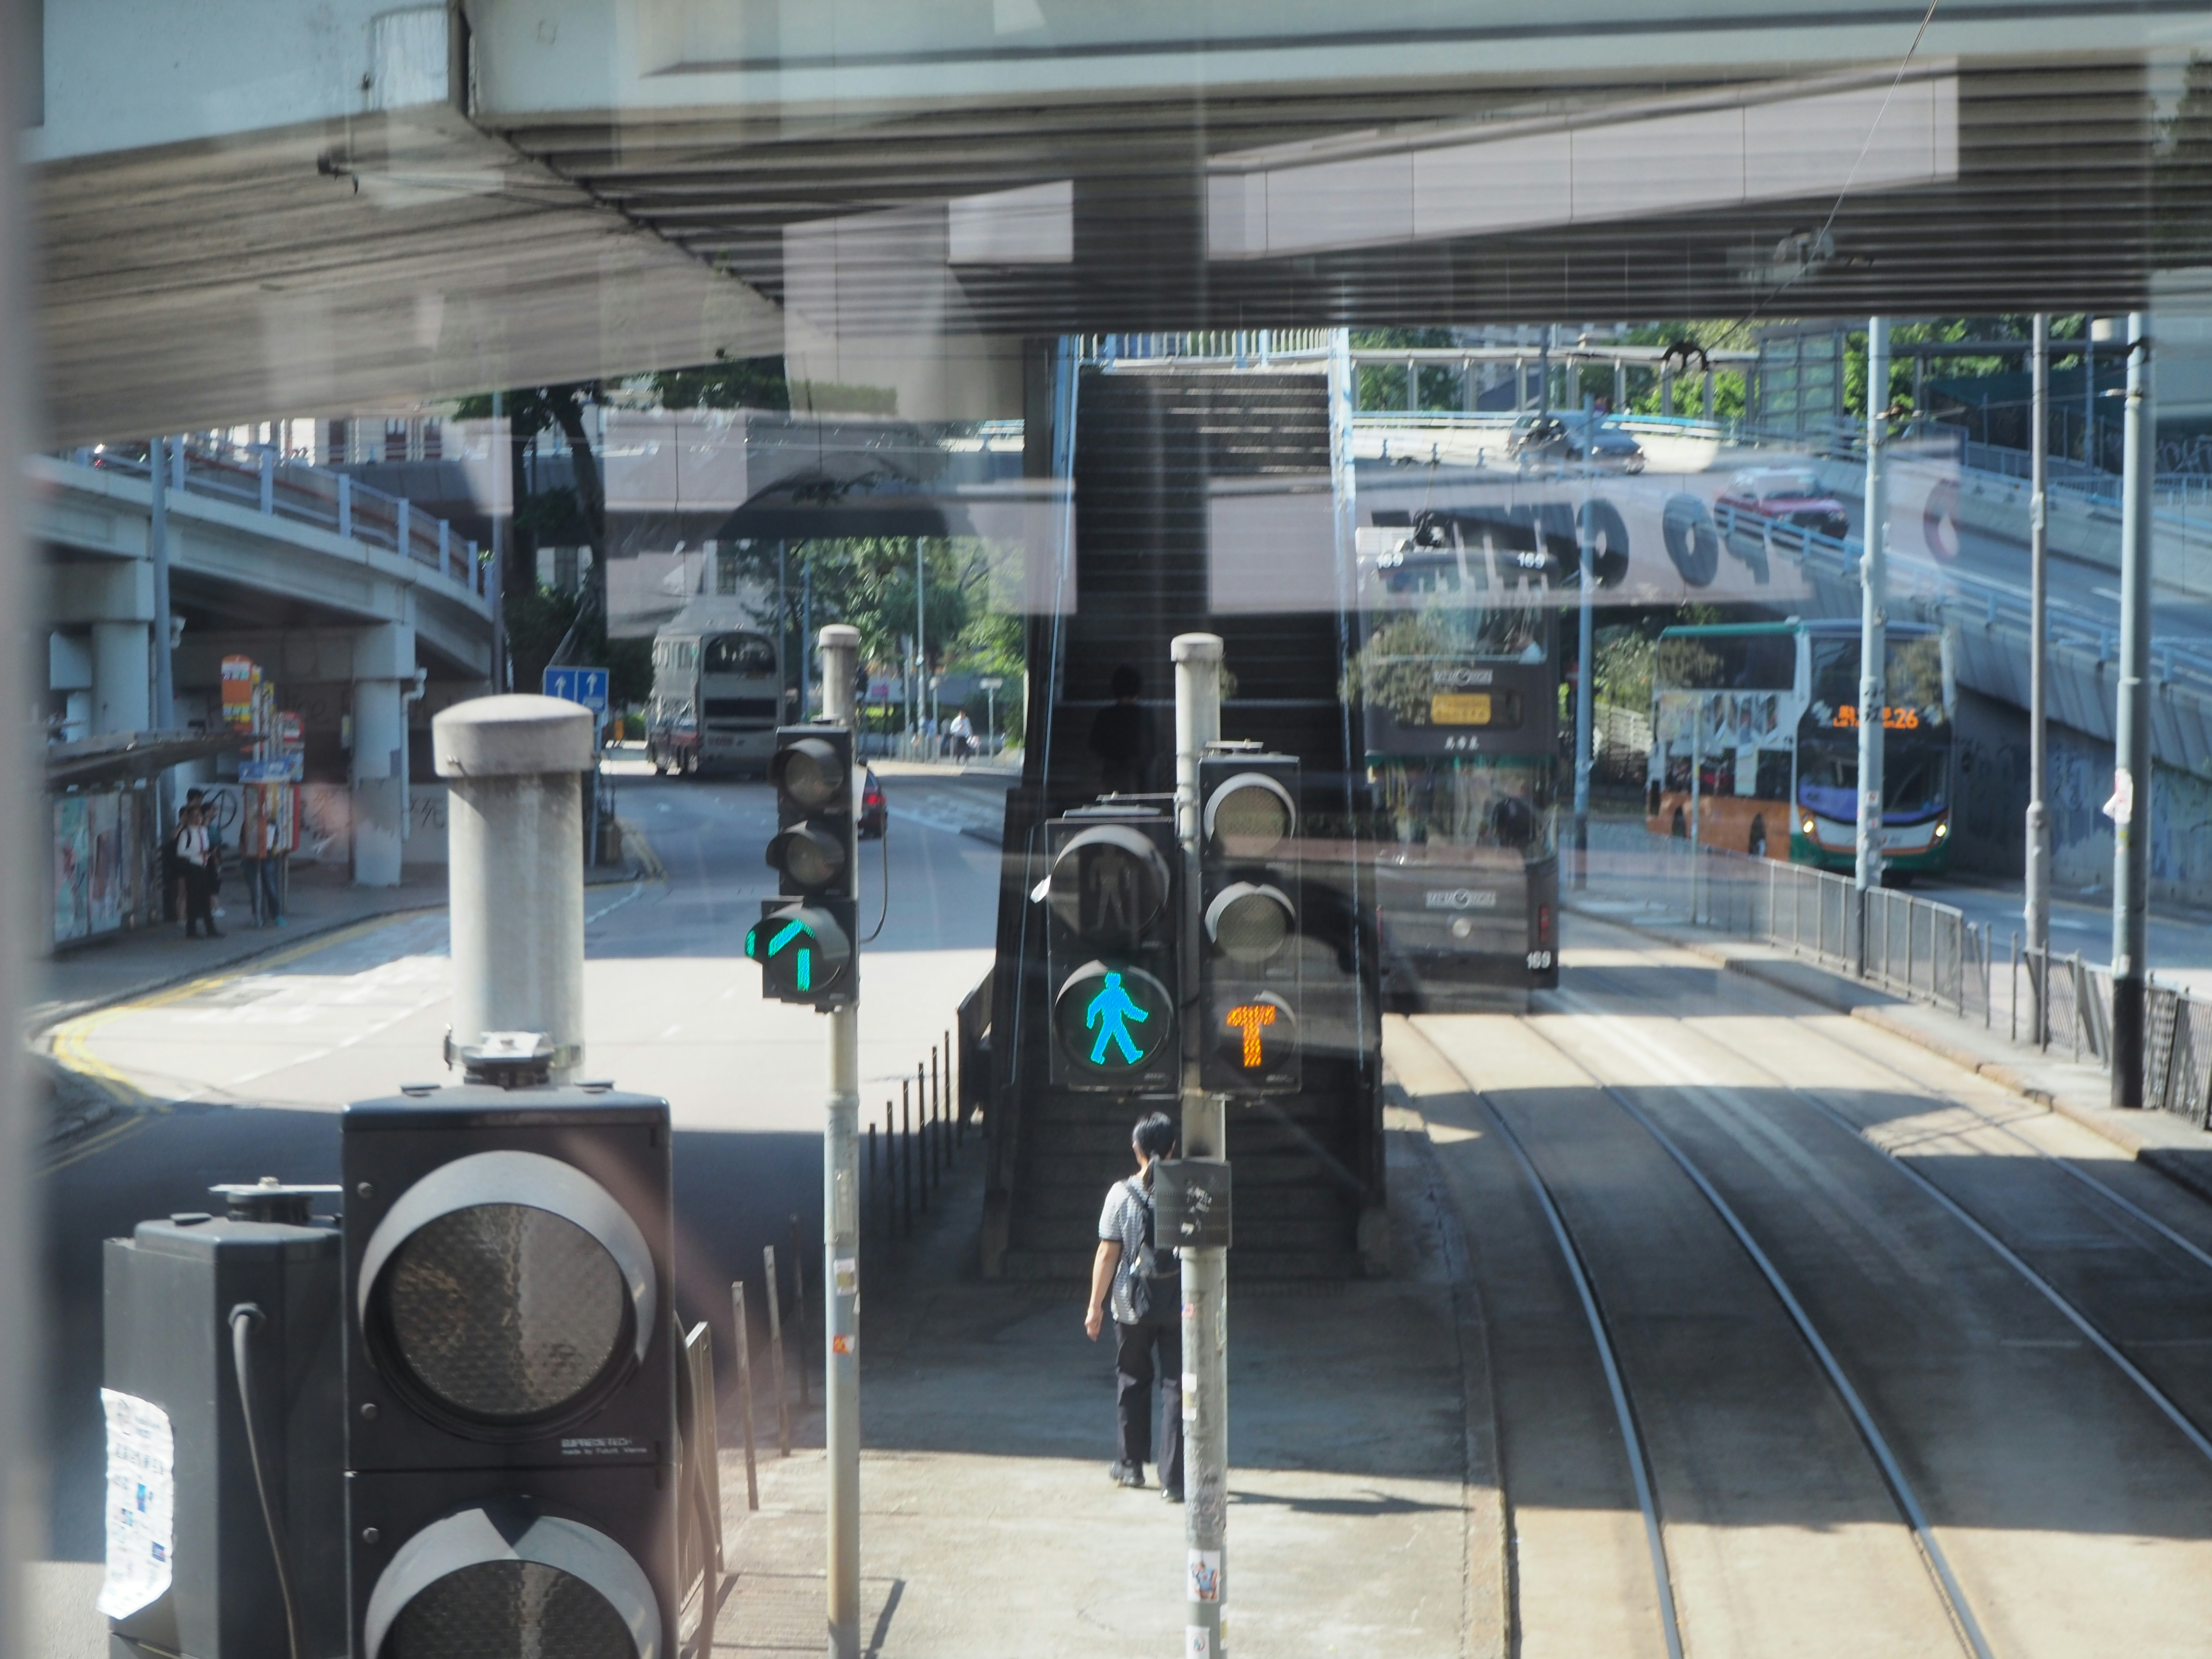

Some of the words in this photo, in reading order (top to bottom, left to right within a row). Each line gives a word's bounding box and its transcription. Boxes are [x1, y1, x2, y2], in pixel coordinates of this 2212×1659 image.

[1376, 551, 1404, 569] 169
[1517, 551, 1546, 569] 169
[1894, 708, 1919, 729] 26
[1527, 950, 1551, 970] 169
